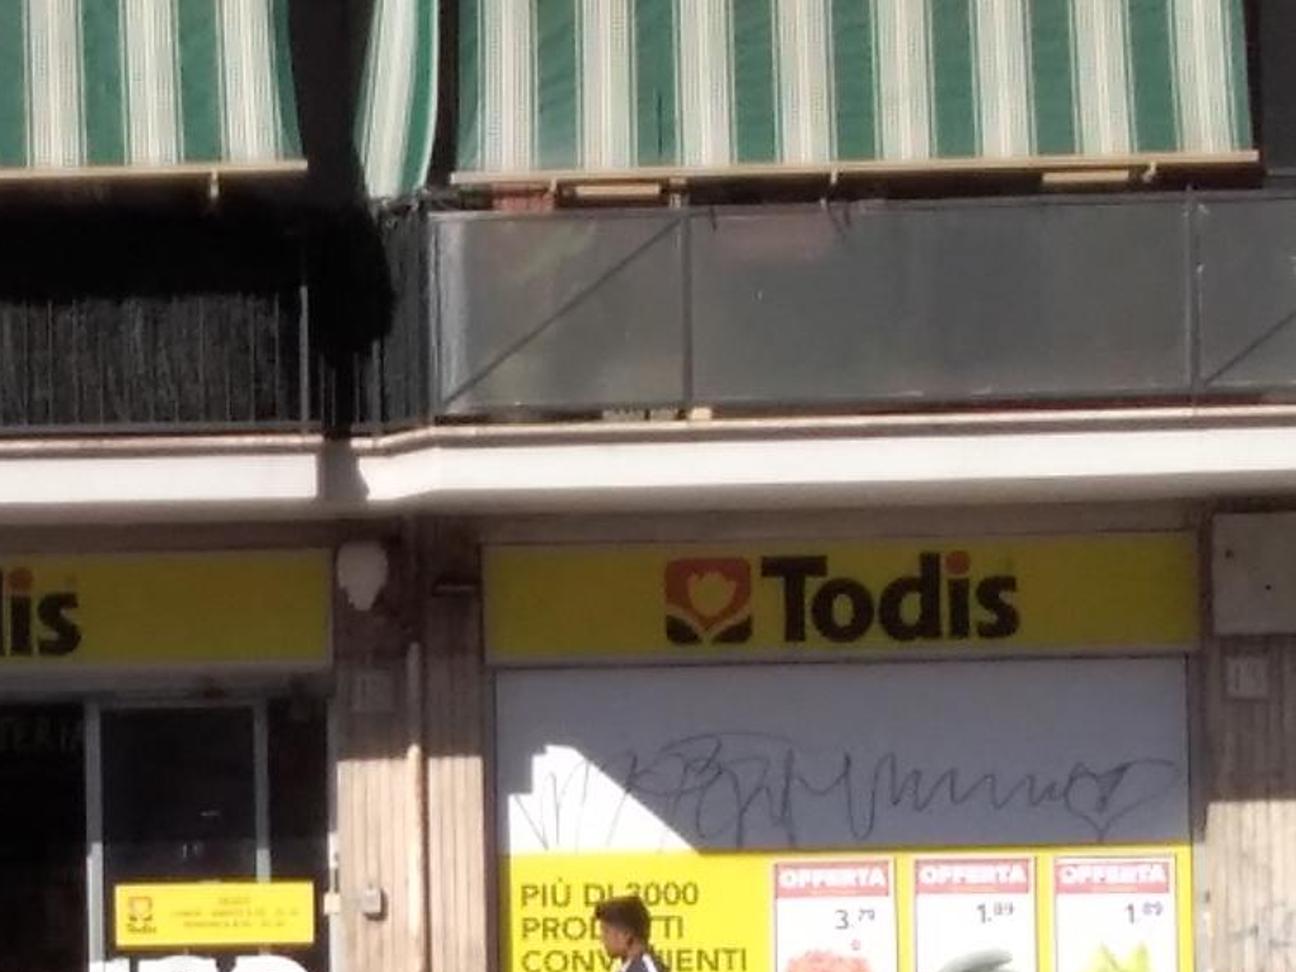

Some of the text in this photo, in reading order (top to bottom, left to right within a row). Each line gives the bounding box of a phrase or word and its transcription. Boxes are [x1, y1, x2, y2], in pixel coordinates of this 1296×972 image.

[761, 550, 1019, 642] Todis
[779, 867, 886, 888] OFFERTA
[919, 863, 1025, 885] OFFERTA
[1058, 863, 1166, 884] OFFERTA
[521, 878, 571, 907] PIÙ
[584, 883, 614, 906] DI
[521, 916, 684, 940] PRODTI
